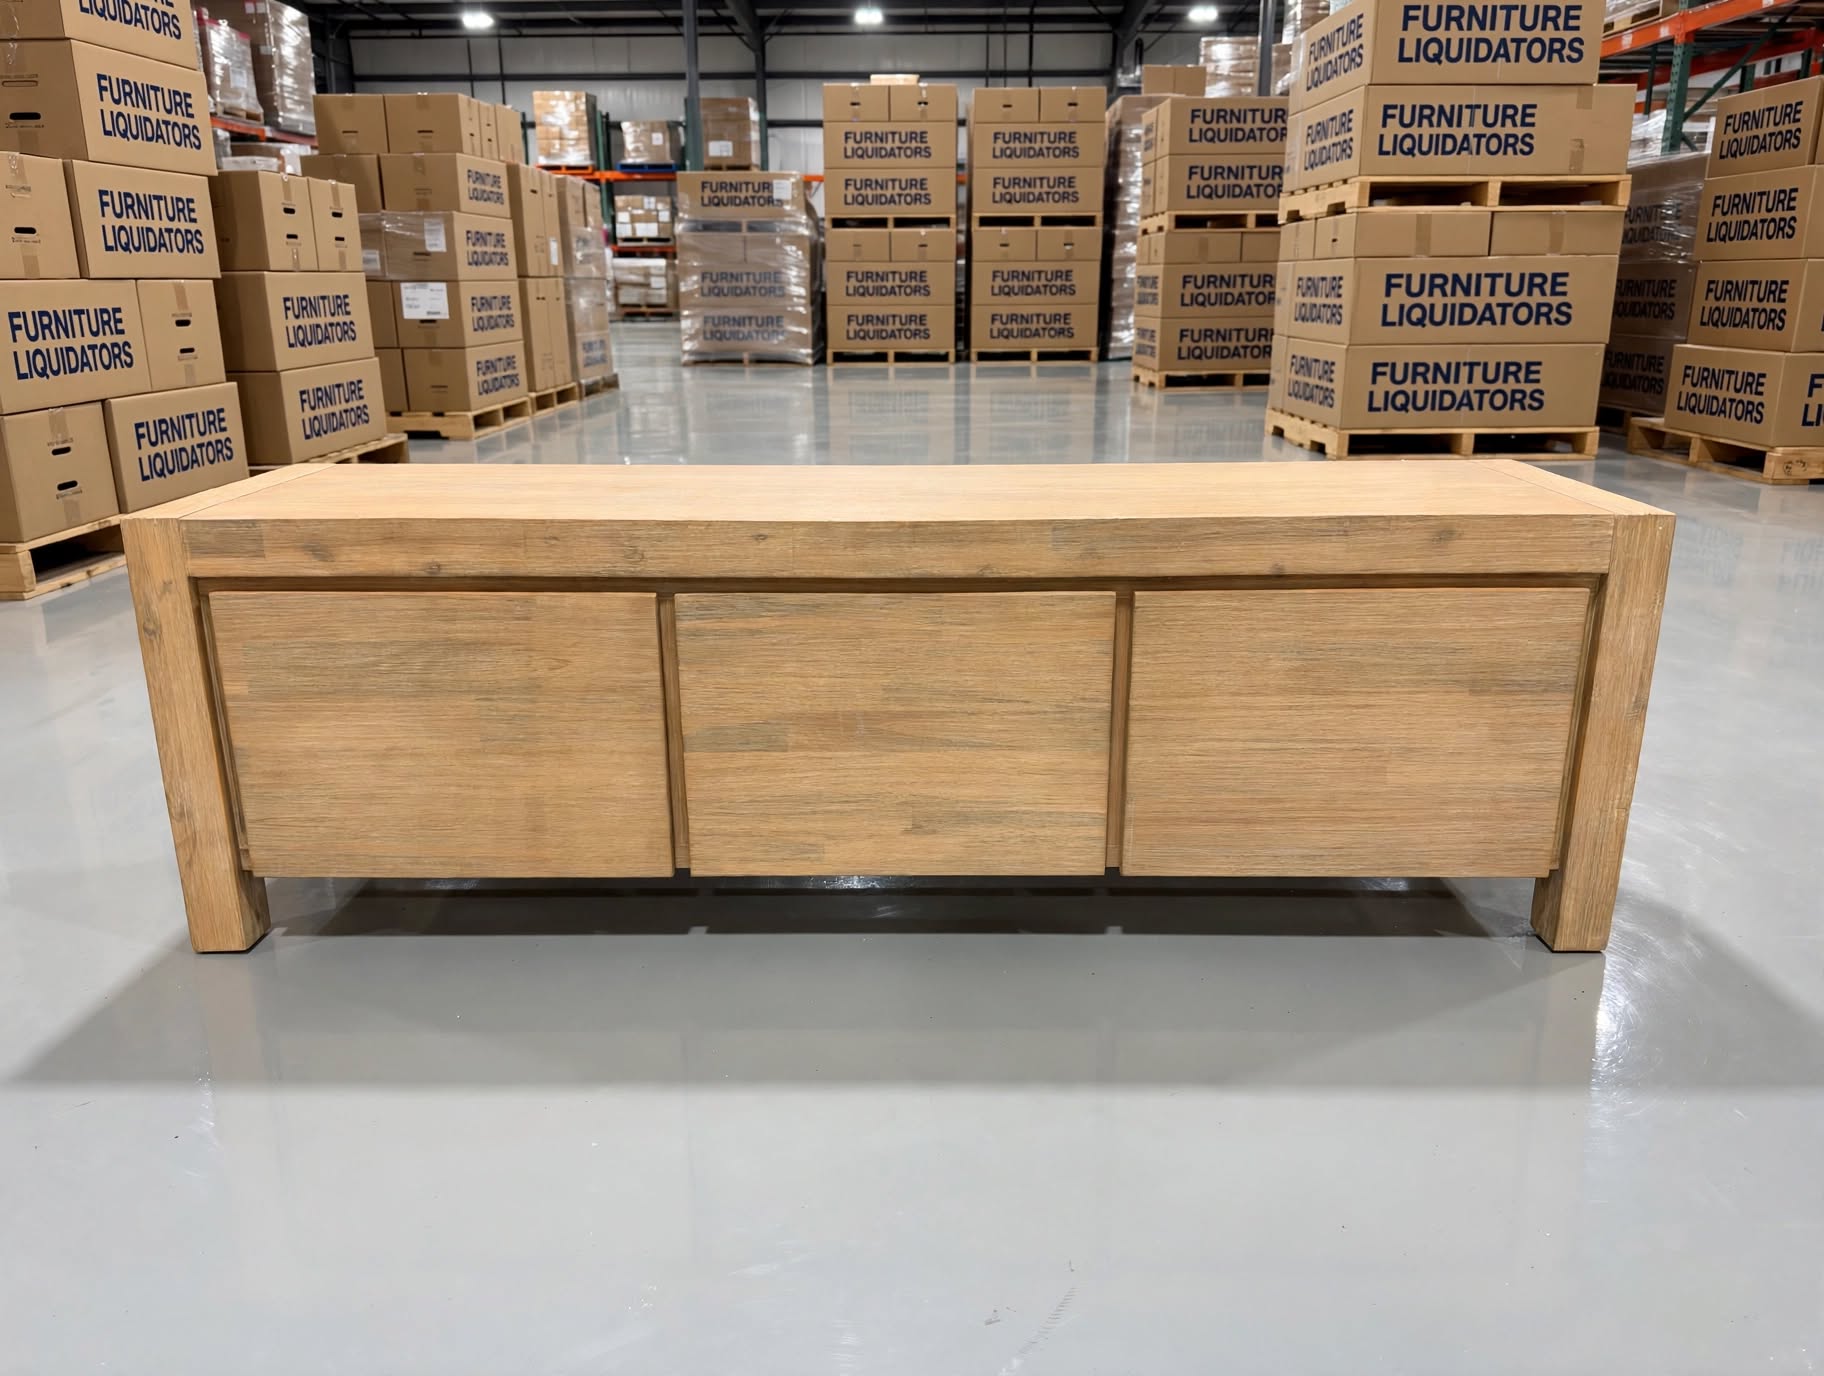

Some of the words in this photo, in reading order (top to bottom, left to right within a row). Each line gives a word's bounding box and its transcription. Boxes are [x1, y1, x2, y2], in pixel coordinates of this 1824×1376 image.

[1402, 4, 1582, 31] FURNITURE
[1308, 13, 1364, 64] FURNITURE
[1398, 37, 1584, 66] LIQUIDATORS
[1306, 43, 1364, 91] LIQUIDATORS
[96, 73, 195, 118] FURNITURE
[100, 108, 202, 150] LIQUIDATORS
[1190, 108, 1288, 124] FURNITUR
[1306, 108, 1354, 146] FURNITURE
[1382, 104, 1537, 128] FURNITURE
[1724, 101, 1803, 134] FURNITURE
[844, 131, 928, 144] FURNITURE
[993, 131, 1077, 144] FURNITURE
[1377, 132, 1535, 158] LIQUIDATORS
[1719, 128, 1802, 160] LIQUIDATORS
[843, 146, 931, 160] LIQUIDATORS
[992, 146, 1079, 160] LIQUIDATORS
[1304, 137, 1354, 171] LIQUIDATORS
[844, 178, 928, 191] FURNITURE
[993, 176, 1076, 190] FURNITURE
[98, 189, 198, 224] FURNITURE
[843, 193, 931, 207] LIQUIDATORS
[992, 190, 1079, 204] LIQUIDATORS
[1711, 187, 1799, 217] FURNITURE
[102, 225, 205, 255] LIQUIDATORS
[1706, 215, 1797, 243] LIQUIDATORS
[846, 271, 927, 283] FURNITURE
[991, 270, 1074, 282] FURNITURE
[1297, 276, 1343, 298] FURNITURE
[1385, 272, 1570, 297] FURNITURE
[845, 285, 931, 298] LIQUIDATORS
[990, 284, 1076, 297] LIQUIDATORS
[1705, 279, 1789, 303] FURNITURE
[283, 294, 351, 320] FURNITURE
[847, 314, 927, 326] FURNITURE
[990, 313, 1072, 325] FURNITURE
[1294, 302, 1343, 326] LIQUIDATORS
[1381, 302, 1573, 328] LIQUIDATORS
[1699, 305, 1787, 332] LIQUIDATORS
[8, 307, 126, 343] FURNITURE
[286, 320, 357, 349] LIQUIDATORS
[846, 328, 930, 341] LIQUIDATORS
[990, 327, 1074, 340] LIQUIDATORS
[1179, 328, 1274, 343] FURNITUR
[13, 341, 134, 380] LIQUIDATORS
[1291, 353, 1337, 383] FURNITURE
[1371, 361, 1543, 385] FURNITURE
[1682, 365, 1767, 396] FURNITURE
[299, 379, 365, 412] FURNITURE
[1367, 389, 1545, 414] LIQUIDATORS
[1676, 391, 1765, 424] LIQUIDATORS
[134, 408, 228, 450] FURNITURE
[302, 404, 370, 440] LIQUIDATORS
[138, 437, 234, 482] LIQUIDATORS
